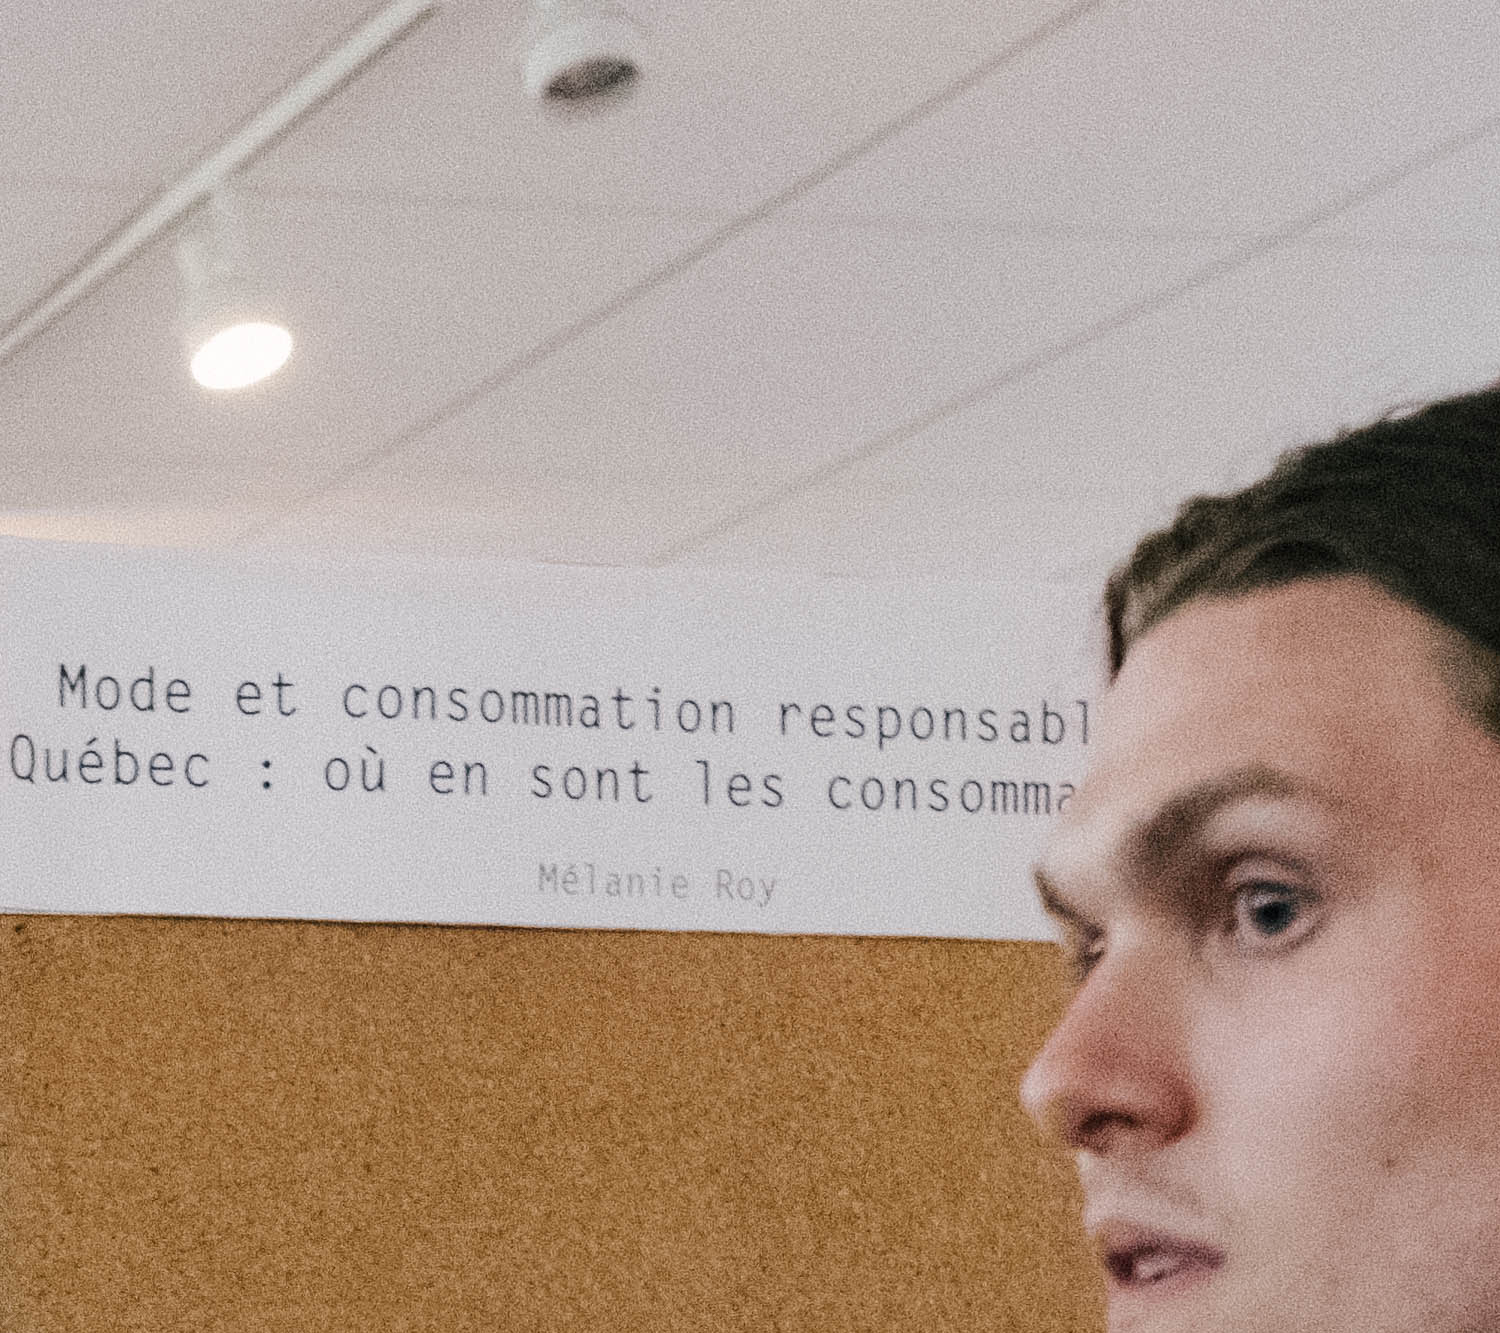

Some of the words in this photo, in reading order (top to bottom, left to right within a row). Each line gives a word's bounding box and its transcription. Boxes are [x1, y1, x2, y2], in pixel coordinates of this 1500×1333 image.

[57, 662, 193, 716] Mode
[233, 672, 298, 719] et
[341, 682, 736, 735] consommation
[8, 731, 210, 790] Québec
[322, 743, 387, 794] où
[427, 758, 489, 797] en
[530, 760, 654, 805] sont
[695, 758, 785, 810] les
[537, 862, 689, 899] Mélanie
[715, 868, 777, 908] Roy
